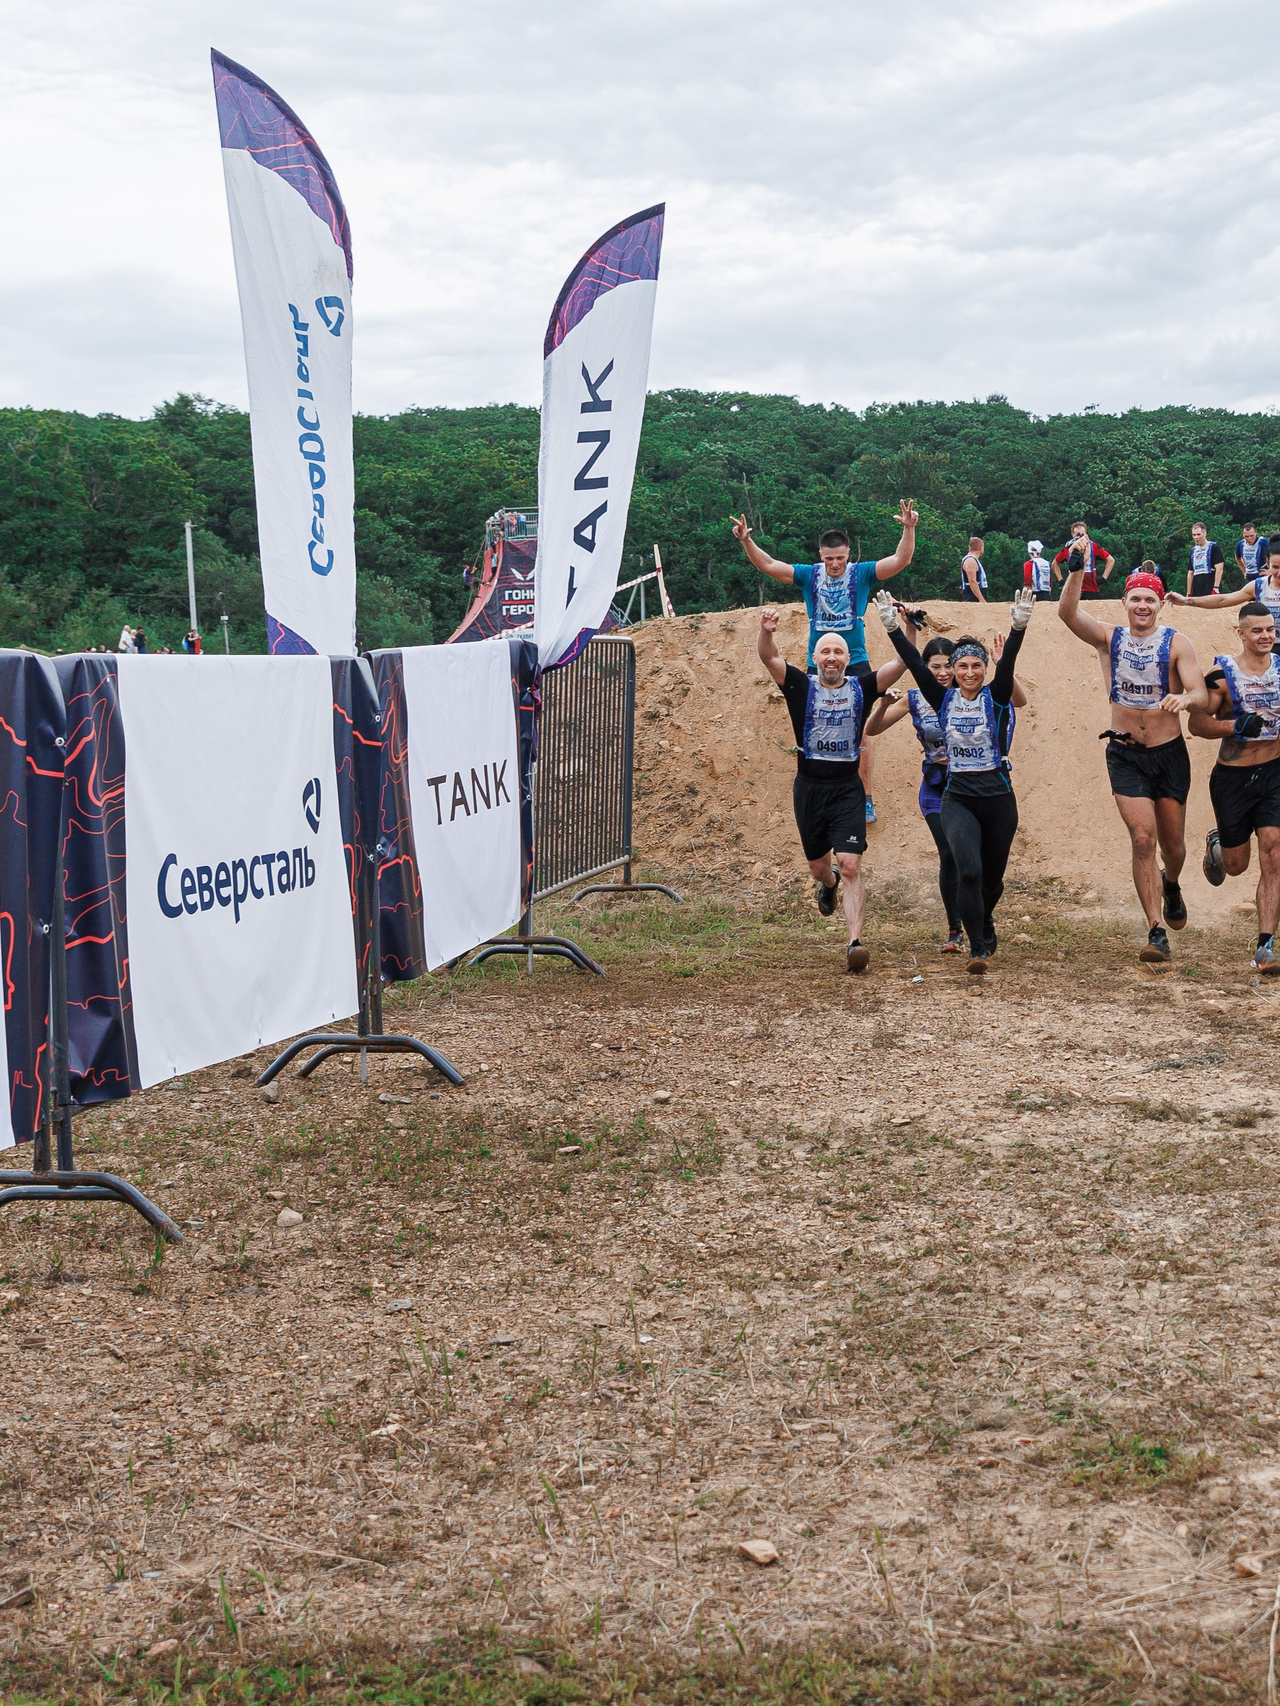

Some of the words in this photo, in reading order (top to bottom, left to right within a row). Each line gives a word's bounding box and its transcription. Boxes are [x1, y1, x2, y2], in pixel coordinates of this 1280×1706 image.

[1122, 681, 1153, 695] 04910
[817, 740, 849, 752] 04909
[953, 747, 985, 758] 04902
[426, 759, 511, 826] TANK
[157, 845, 316, 924] Северсталь
